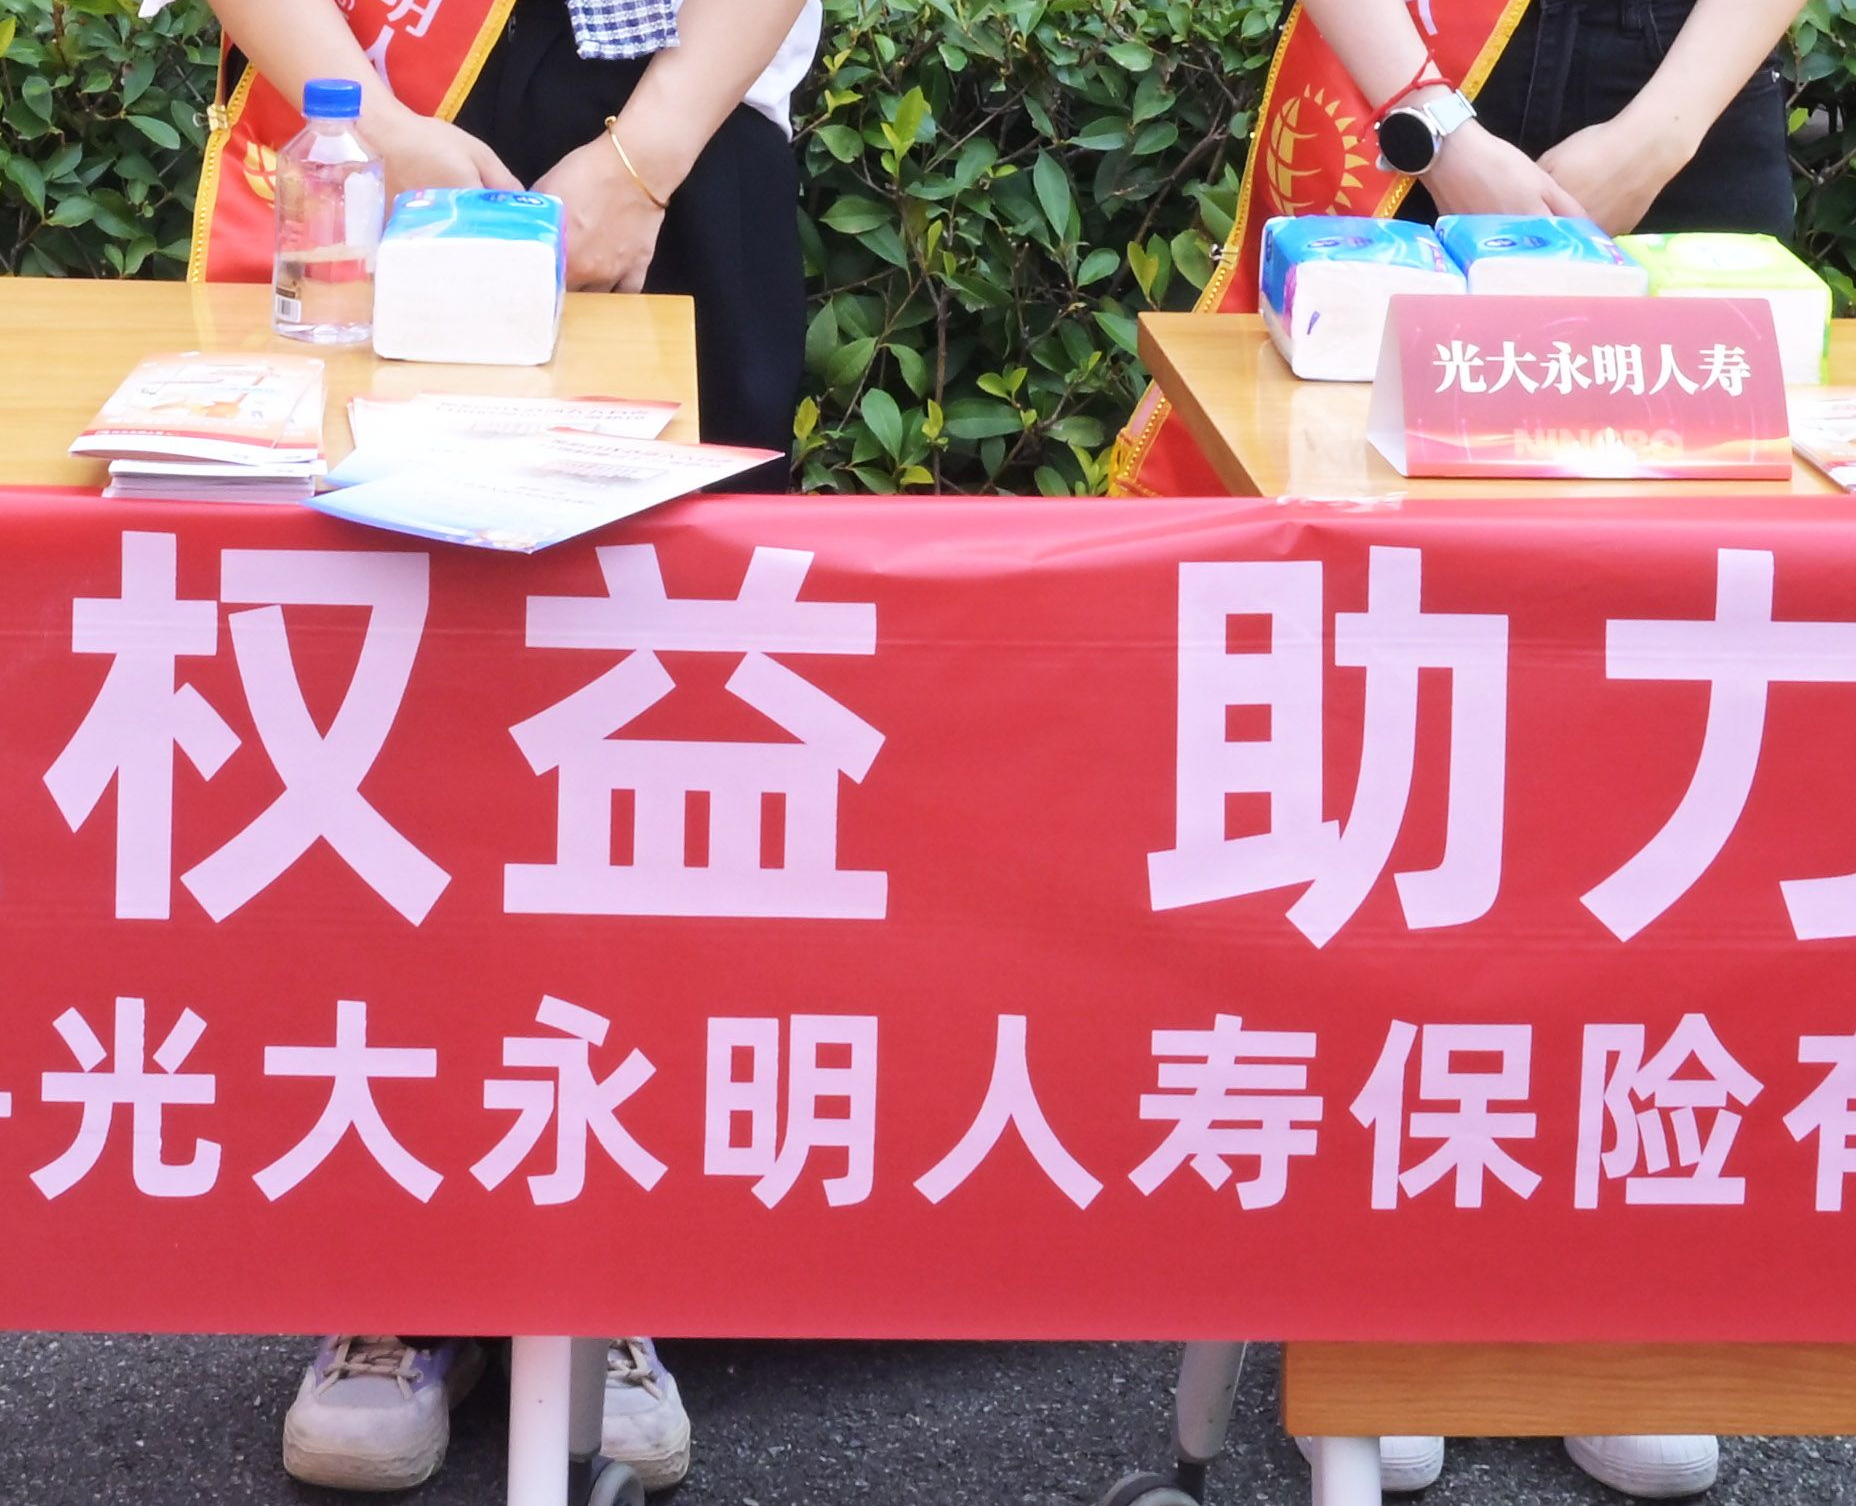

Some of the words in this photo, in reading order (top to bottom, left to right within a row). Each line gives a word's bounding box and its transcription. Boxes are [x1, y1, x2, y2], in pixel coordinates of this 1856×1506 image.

[1431, 338, 1752, 398] 光大永明人寿
